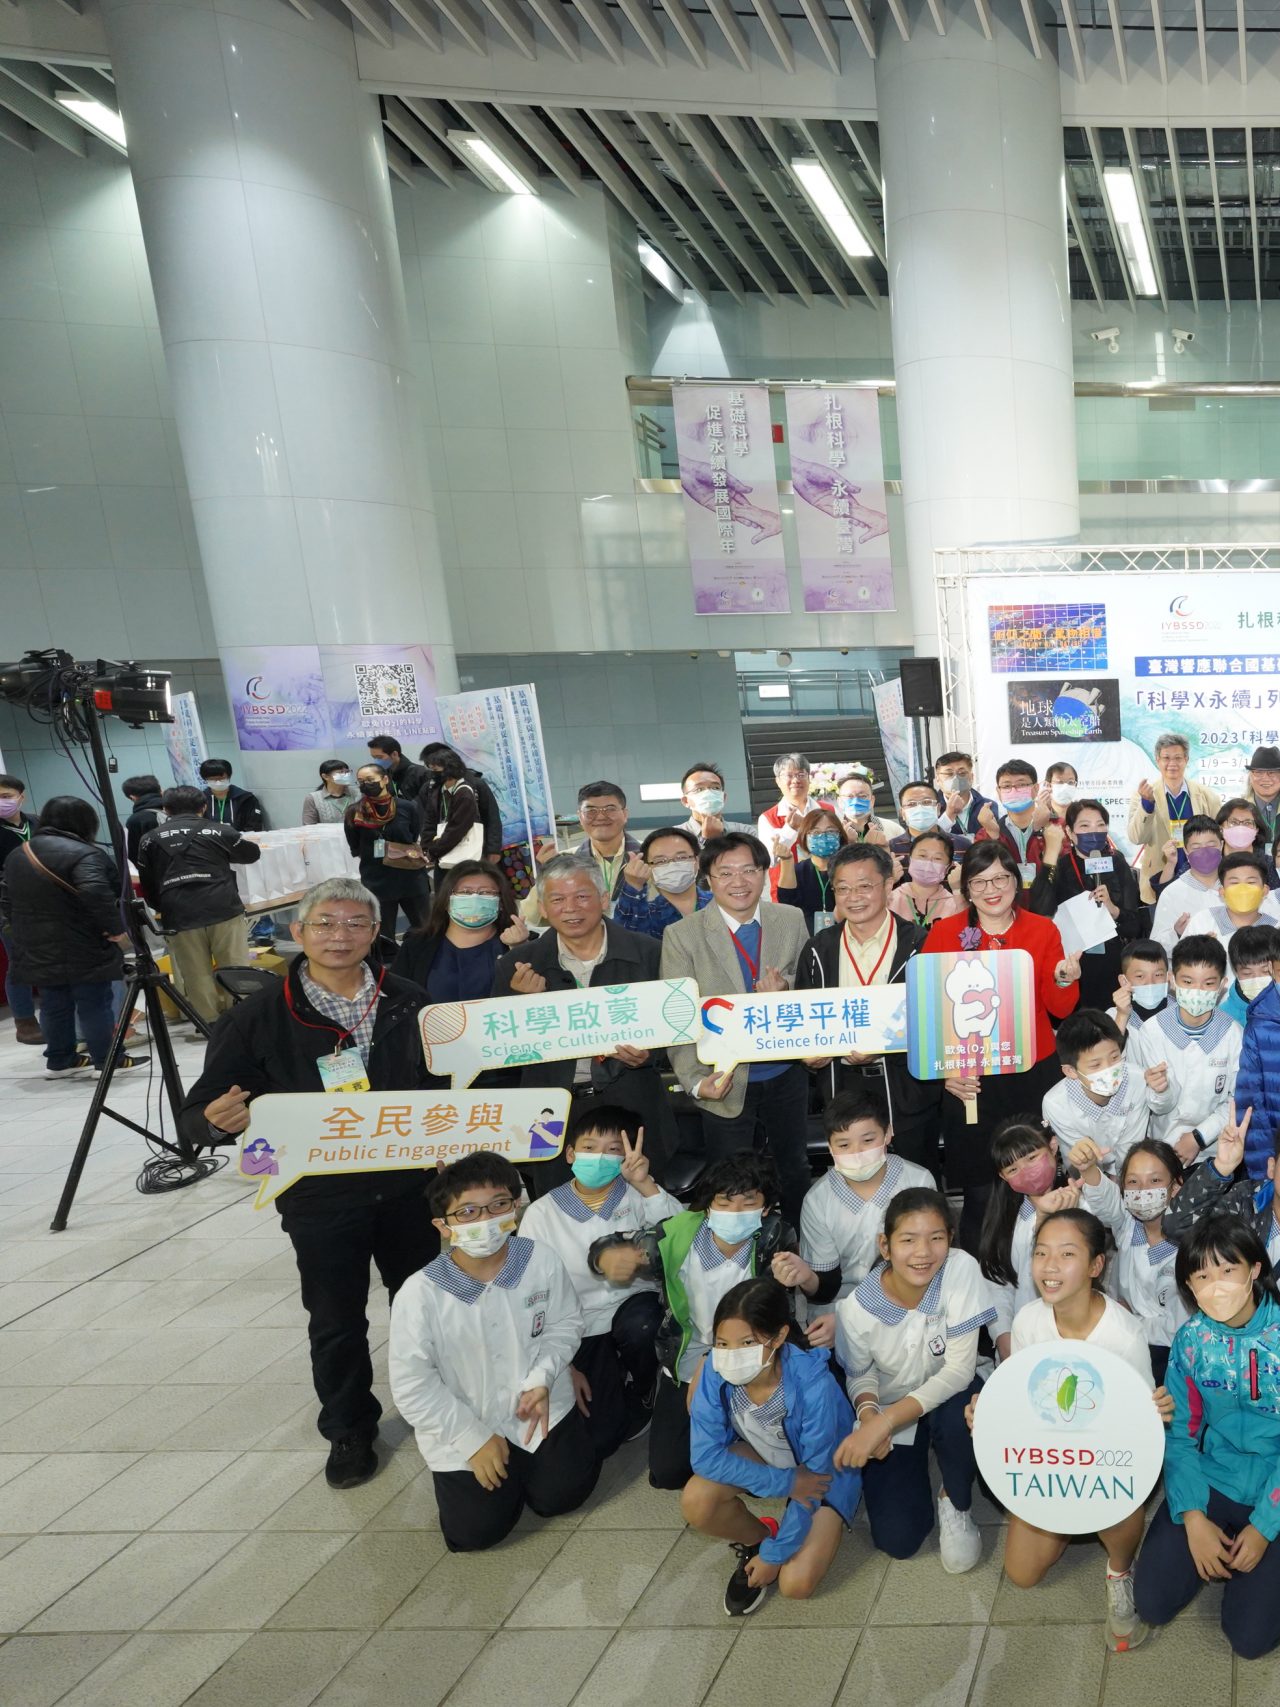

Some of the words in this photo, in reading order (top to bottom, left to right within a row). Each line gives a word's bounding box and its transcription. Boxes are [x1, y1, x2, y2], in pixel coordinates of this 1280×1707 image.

[728, 390, 749, 458] 基礎科學
[823, 393, 846, 469] 扎根科學
[704, 404, 736, 554] 促進永續發展國際年
[1020, 699, 1054, 716] 地球
[1021, 729, 1050, 737] Treasure
[483, 996, 641, 1041] 科學啟蒙
[743, 999, 872, 1035] 科學平權
[481, 1040, 552, 1060] Science
[557, 1026, 656, 1053] Cultivation
[756, 1036, 811, 1051] Science
[814, 1034, 834, 1048] for
[838, 1031, 857, 1045] All
[934, 1057, 977, 1071] 扎根科學
[980, 1055, 1022, 1067] 永續臺灣
[319, 1104, 504, 1142] 全民參與
[308, 1143, 379, 1163] Public
[385, 1138, 512, 1163] Engagement
[1004, 1447, 1133, 1467] IYBSSD2022
[1005, 1472, 1134, 1500] TAIWAN
